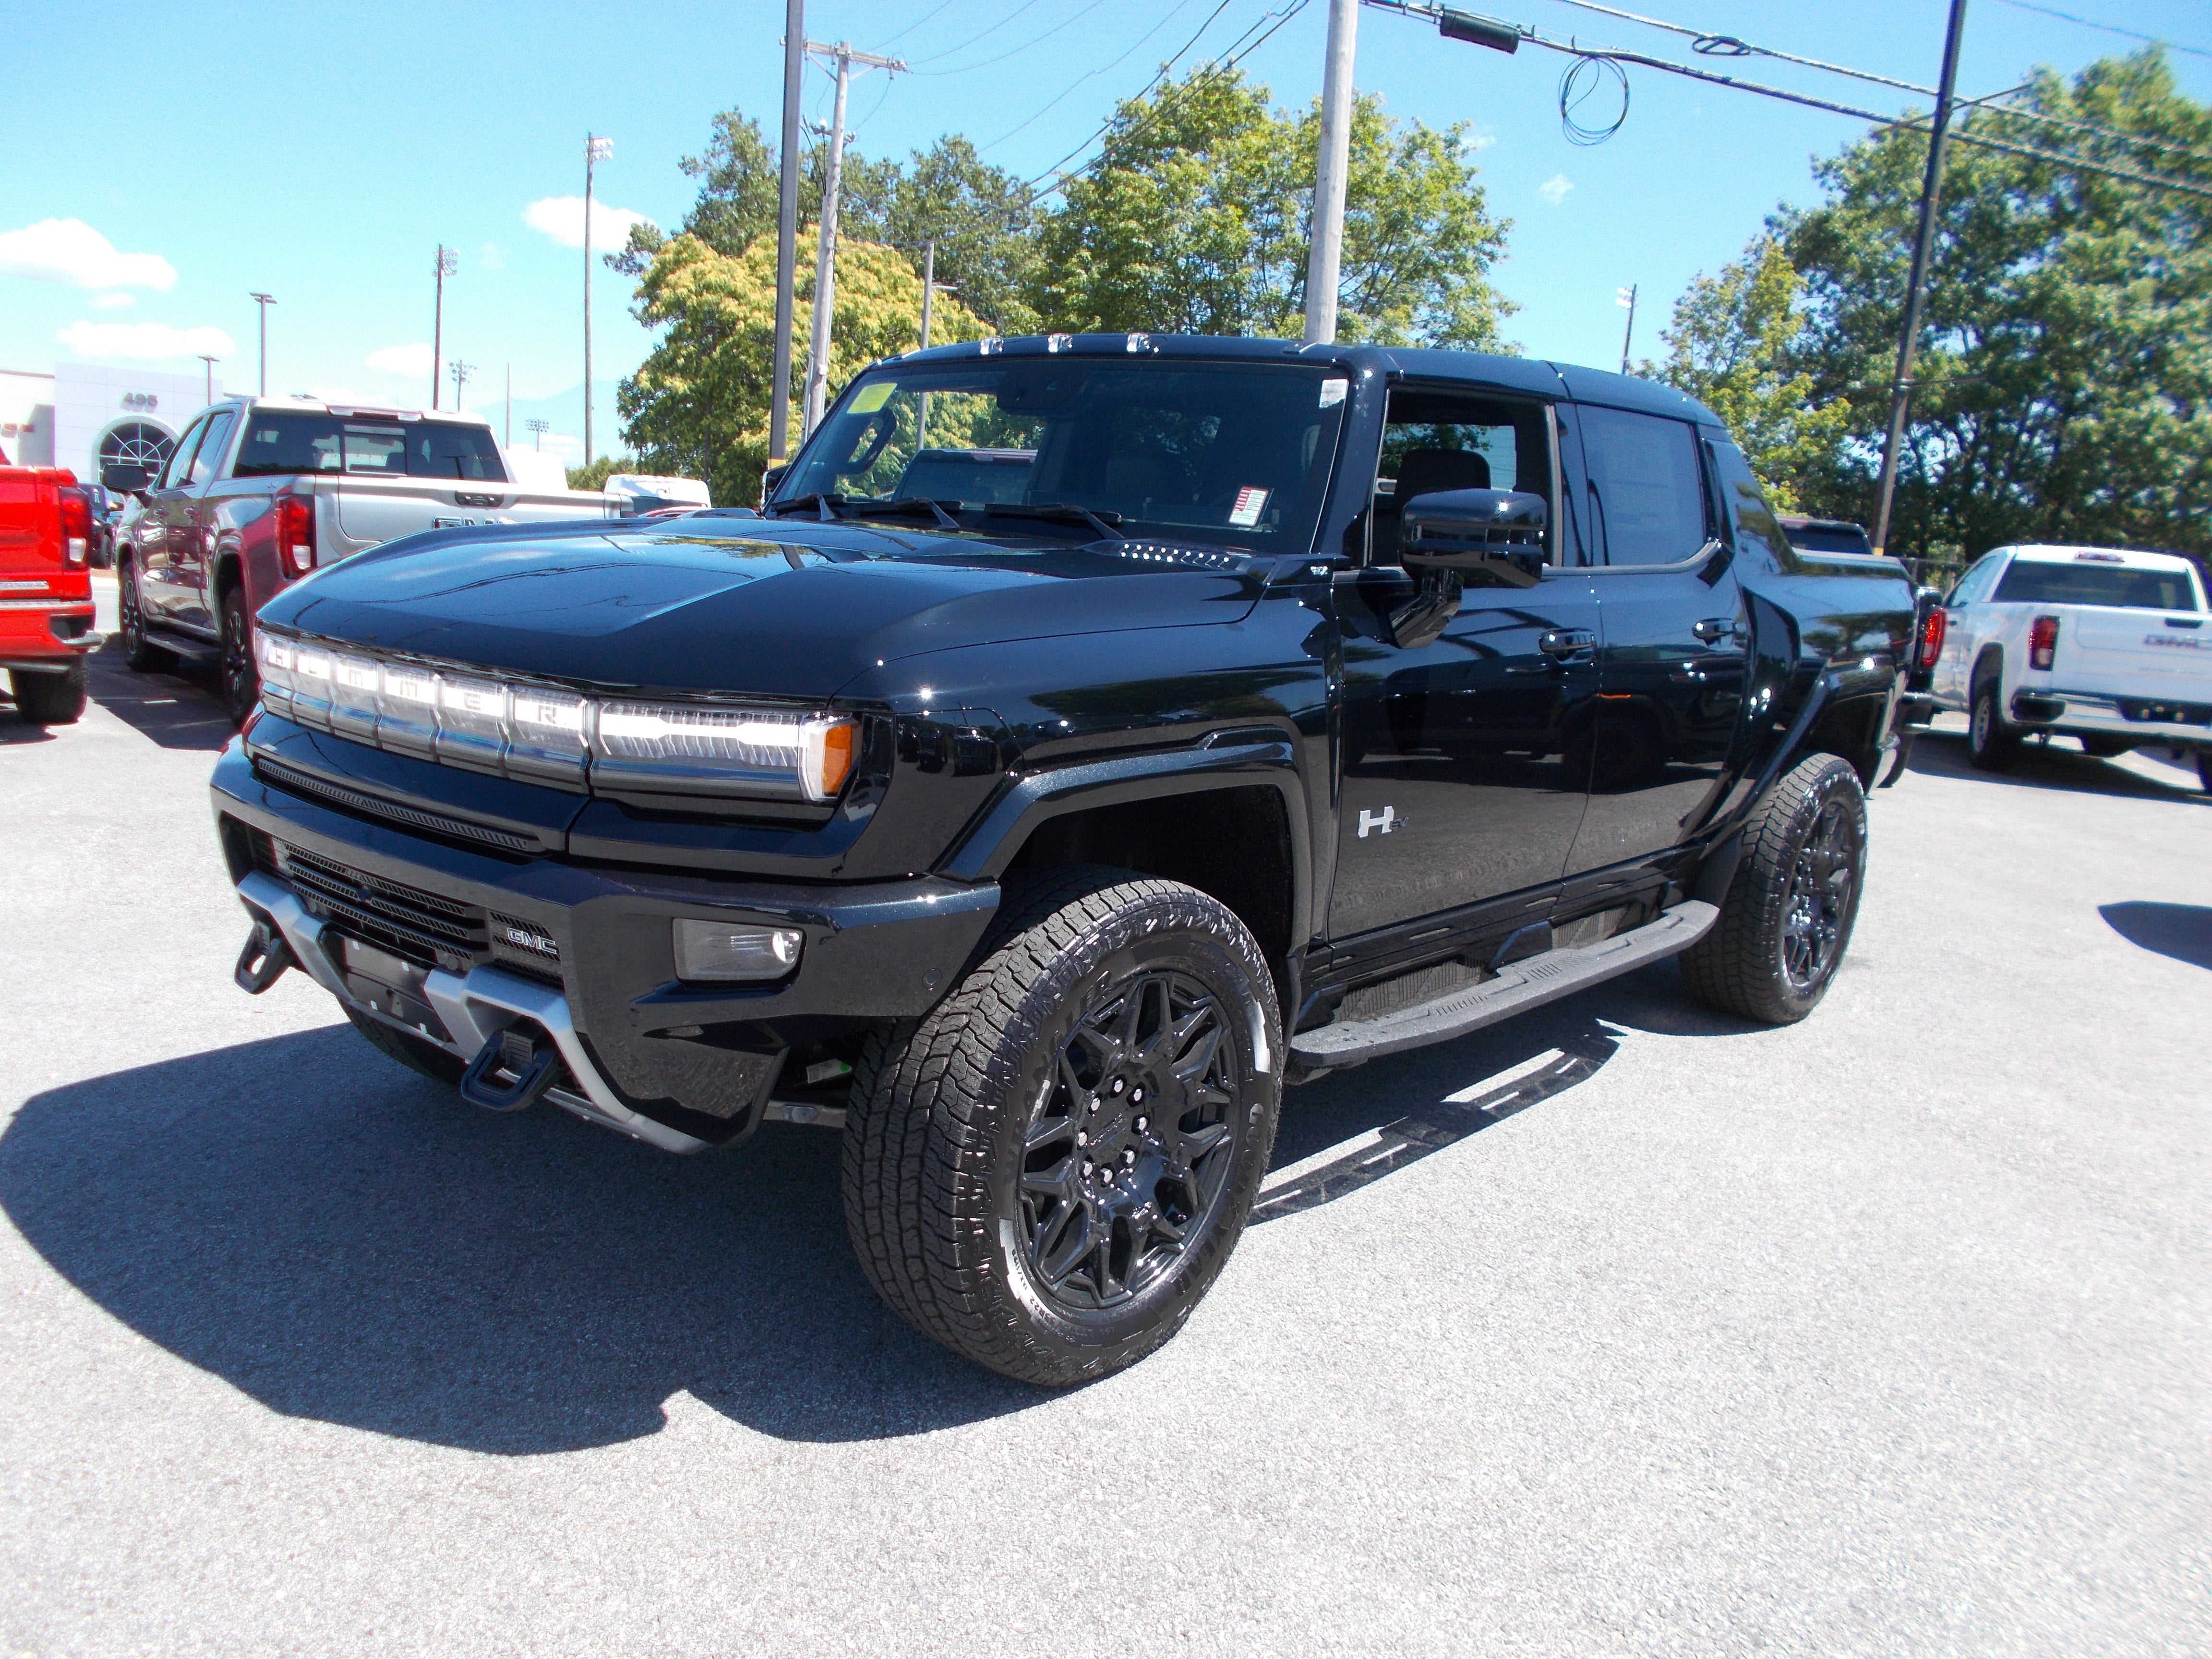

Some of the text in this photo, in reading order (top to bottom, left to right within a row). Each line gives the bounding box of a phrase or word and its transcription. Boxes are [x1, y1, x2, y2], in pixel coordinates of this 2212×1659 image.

[123, 392, 158, 407] 495
[275, 646, 556, 723] HUMMER
[1358, 805, 1395, 838] H
[507, 927, 557, 954] GMC
[1176, 1102, 1264, 1298] GOODYEAR
